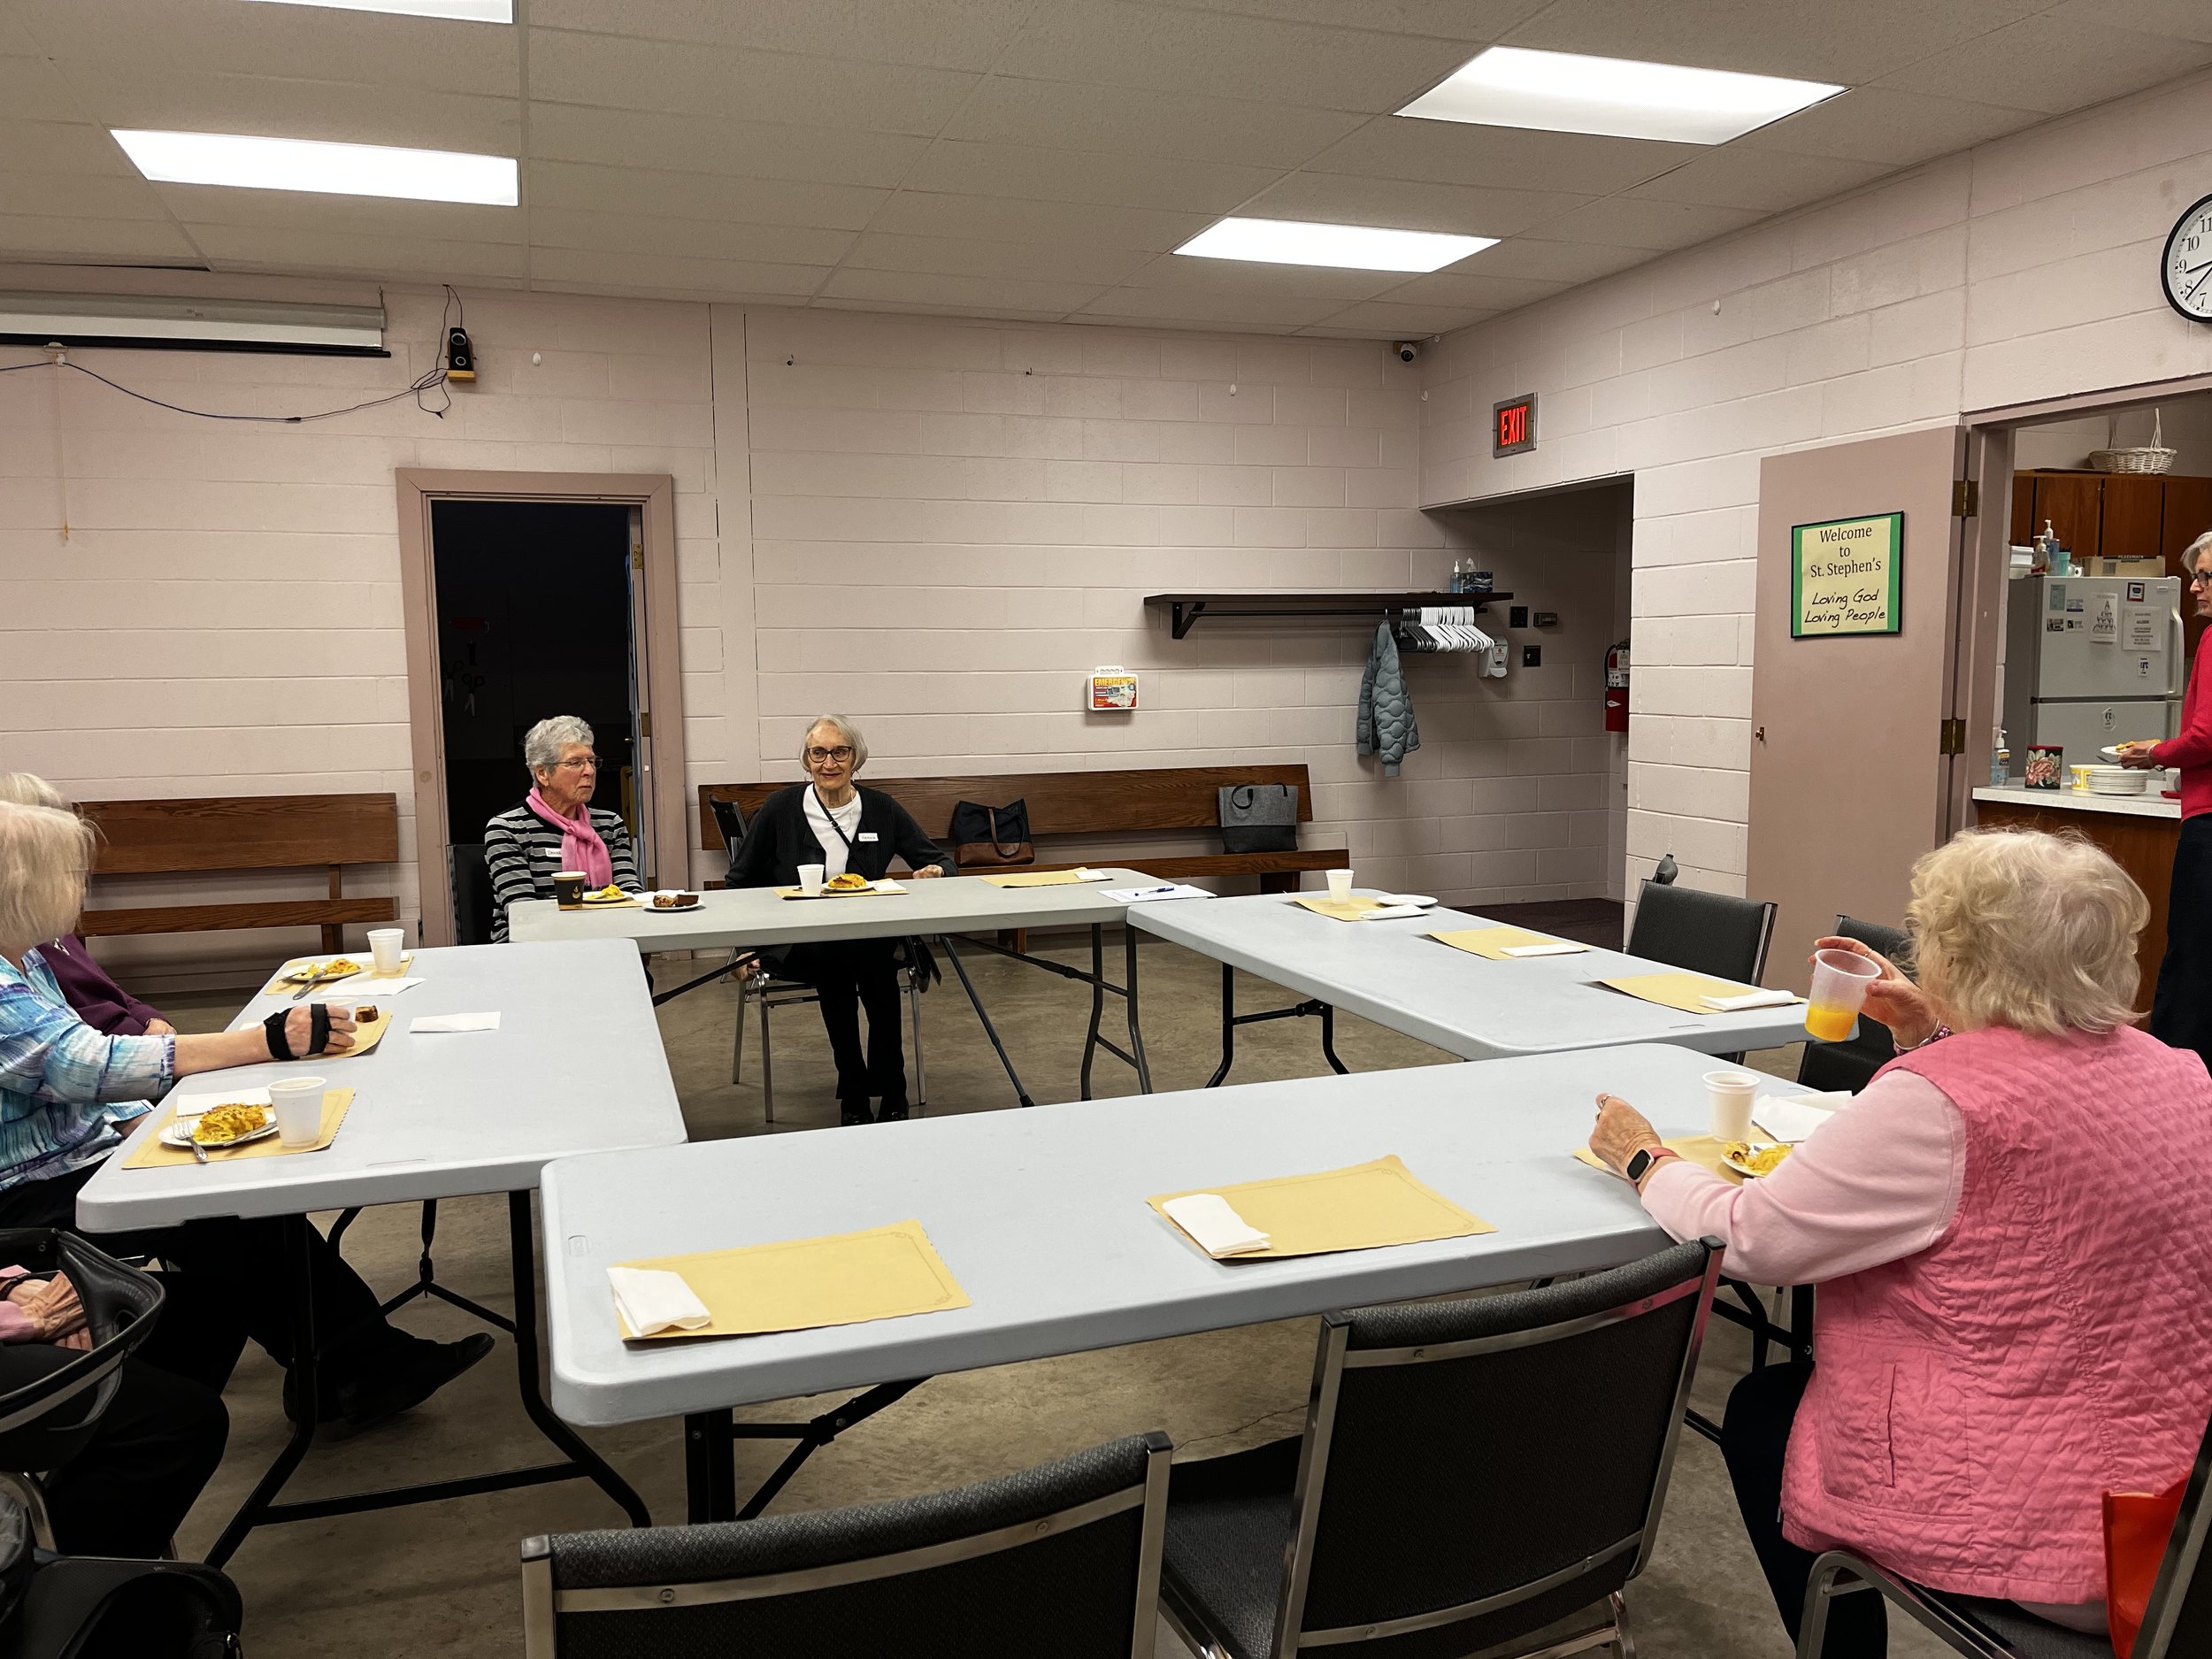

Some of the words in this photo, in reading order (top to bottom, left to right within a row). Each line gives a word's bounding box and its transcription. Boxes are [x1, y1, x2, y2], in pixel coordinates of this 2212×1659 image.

[2200, 217, 2212, 234] 11
[2186, 235, 2200, 251] 10
[2179, 258, 2187, 273] 9
[2185, 280, 2193, 296] 8
[2200, 292, 2208, 307] 7
[1501, 406, 1527, 445] EXIT
[1819, 526, 1872, 543] Welcome
[1839, 546, 1851, 557] to
[1810, 565, 1824, 578] St.
[1827, 557, 1881, 578] Stephen's
[1812, 592, 1847, 610] Loving
[1853, 588, 1879, 603] God
[1804, 611, 1840, 628] Loving
[1846, 606, 1886, 625] People
